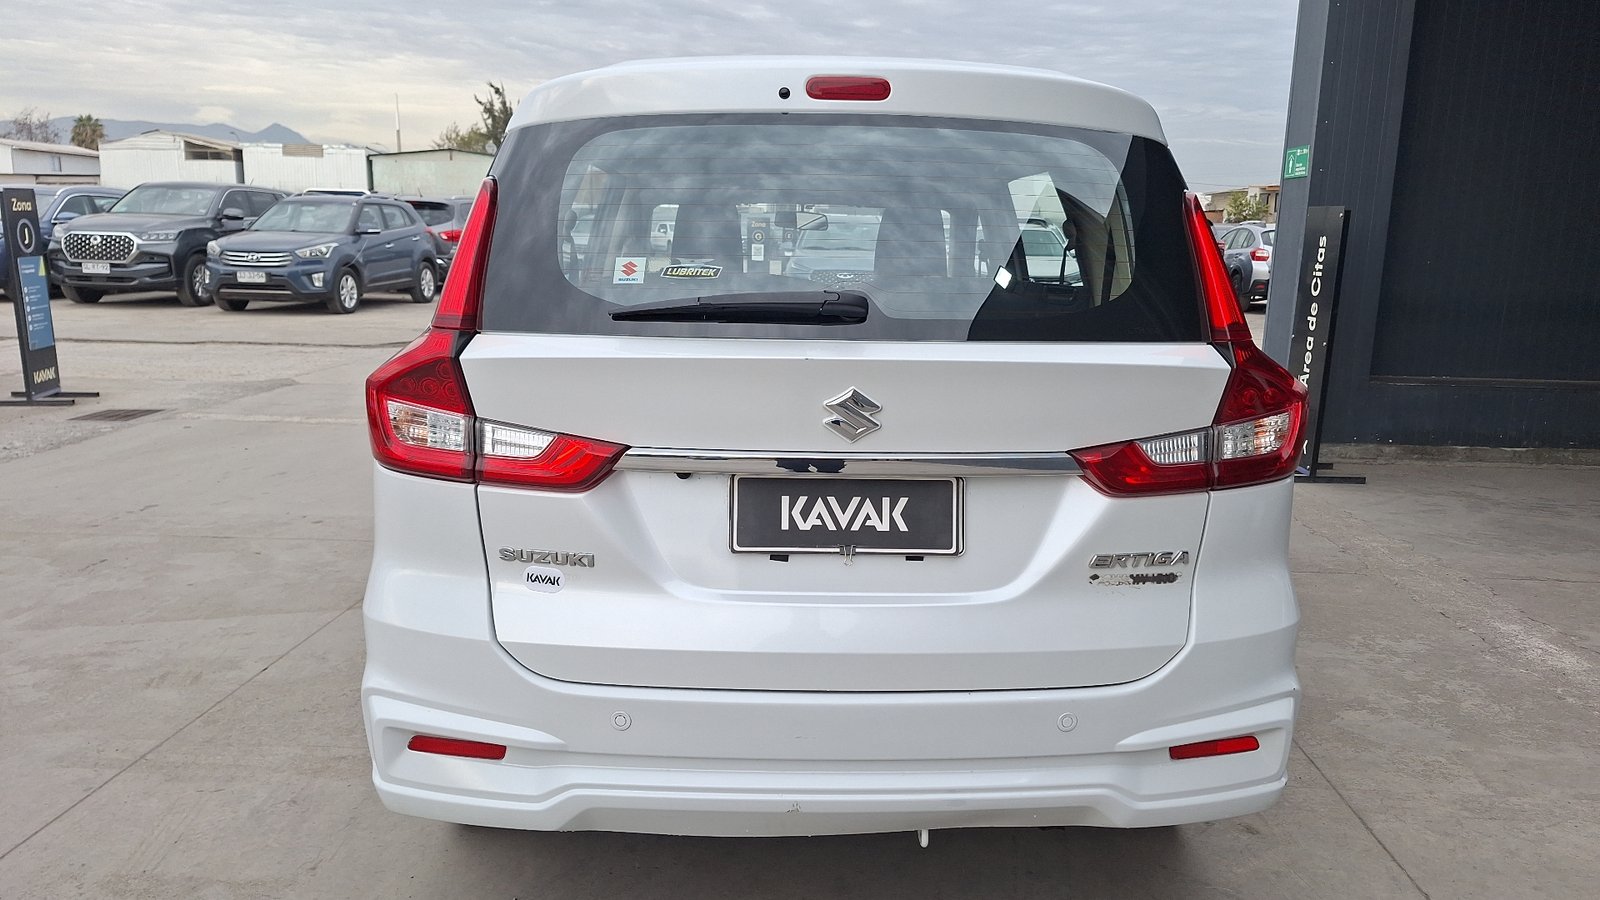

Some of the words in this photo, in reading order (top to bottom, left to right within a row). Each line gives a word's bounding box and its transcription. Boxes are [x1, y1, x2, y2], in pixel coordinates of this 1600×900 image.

[11, 197, 32, 212] Zona
[666, 266, 717, 277] LUBRITEK
[1311, 235, 1327, 297] Citas
[1307, 302, 1319, 331] de
[33, 366, 56, 384] KAVAK
[781, 495, 909, 532] KAVAK
[498, 546, 595, 568] SUZUKI
[1088, 550, 1190, 569] ERTIGA
[526, 572, 561, 587] KAVAK
